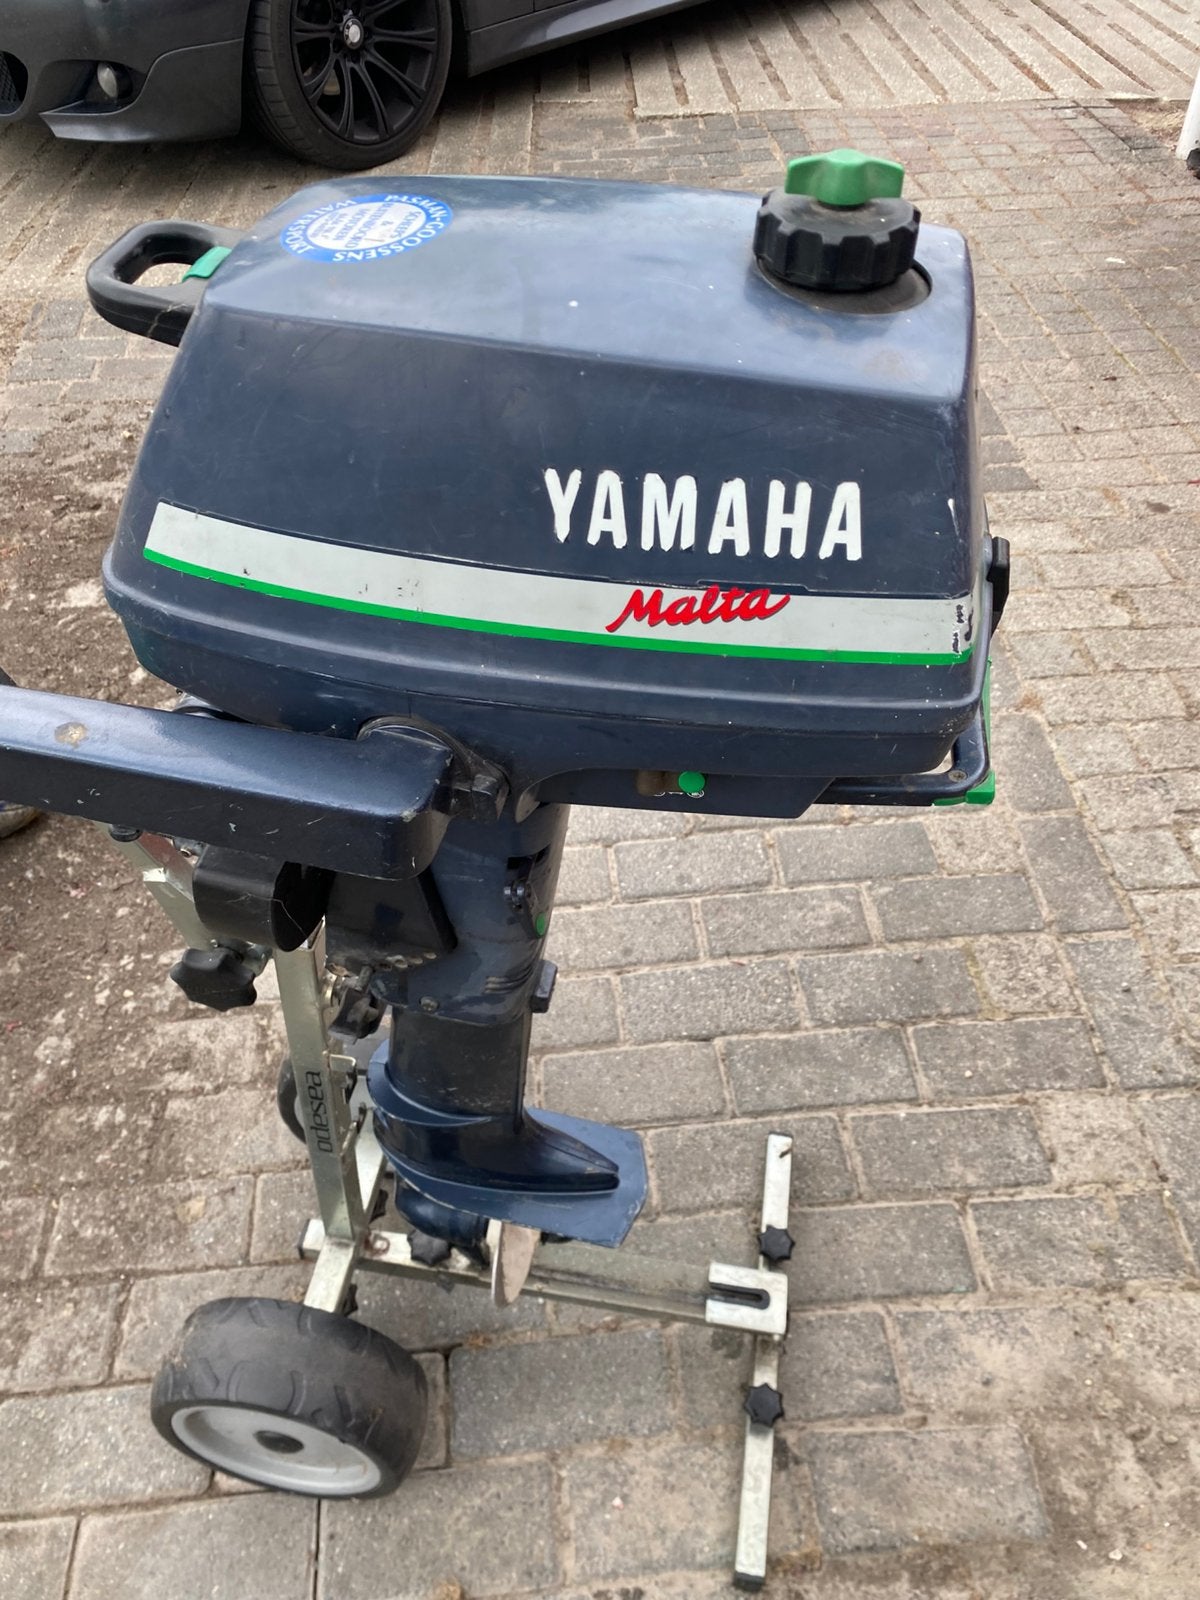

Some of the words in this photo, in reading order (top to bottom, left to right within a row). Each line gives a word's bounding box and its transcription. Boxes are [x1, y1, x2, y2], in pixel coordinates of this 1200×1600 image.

[285, 200, 357, 254] WATERSPORT
[544, 467, 862, 561] YAMAHA
[605, 585, 791, 633] Malta
[305, 1071, 333, 1153] odesea
